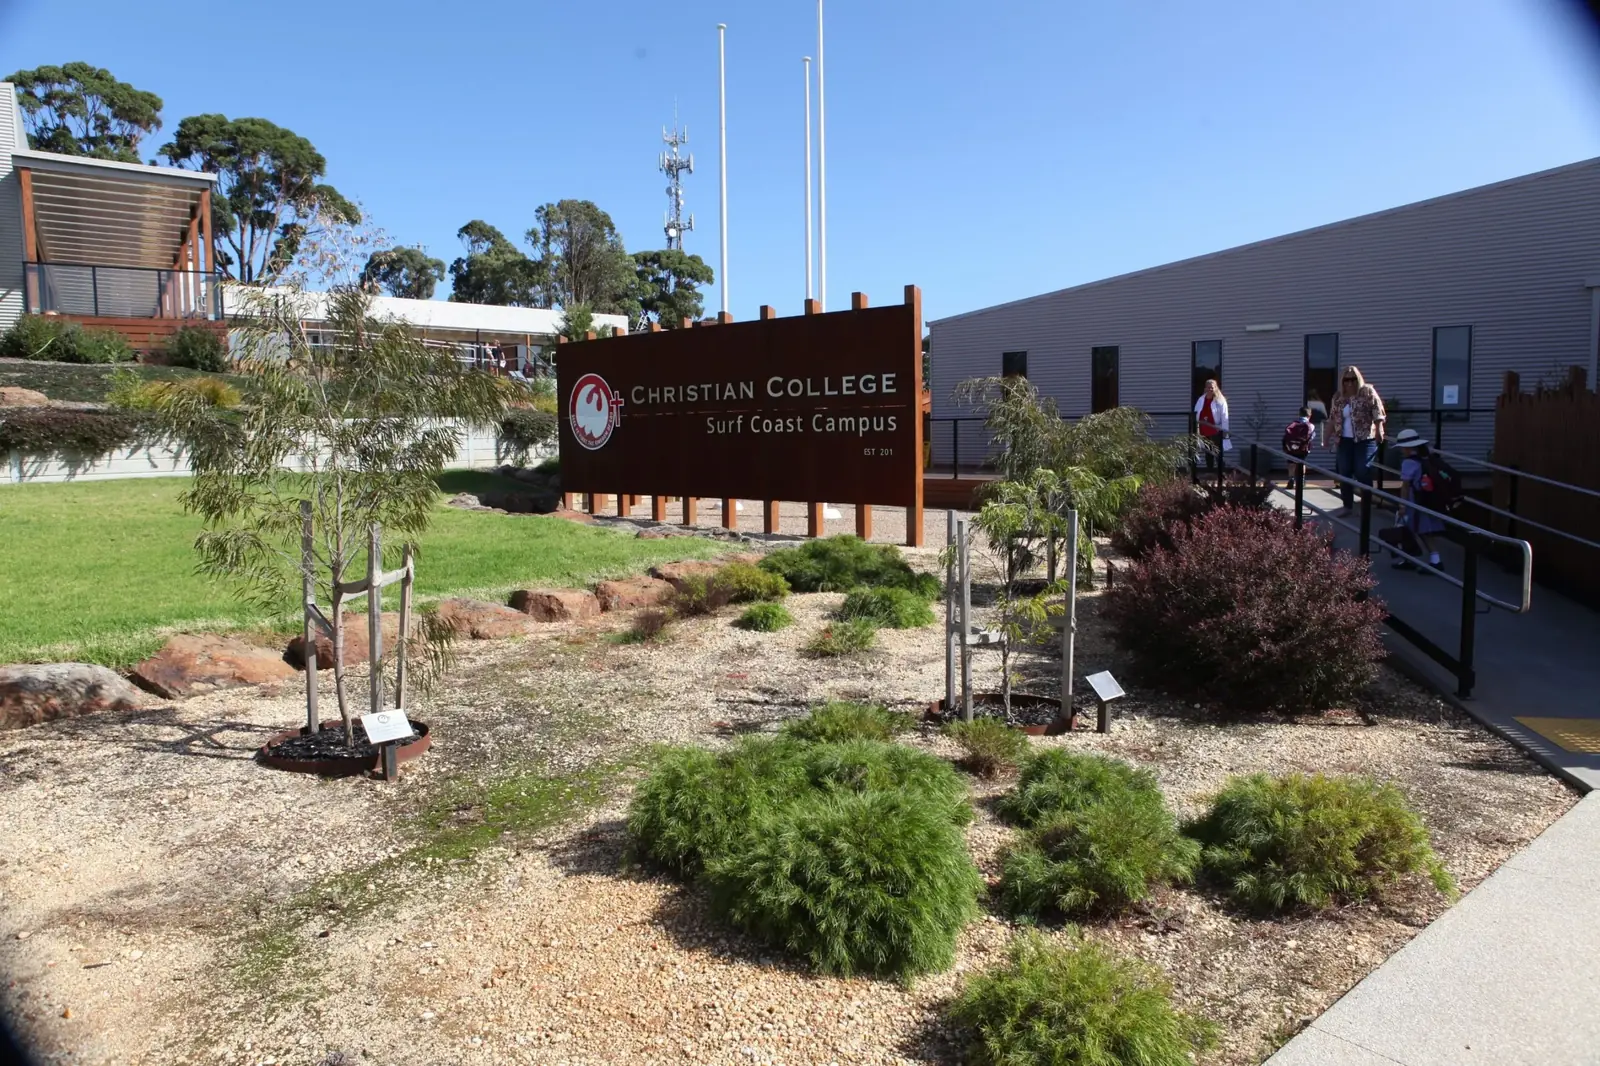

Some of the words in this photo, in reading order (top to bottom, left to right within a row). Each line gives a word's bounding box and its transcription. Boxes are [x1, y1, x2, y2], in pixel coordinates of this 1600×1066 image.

[632, 382, 754, 404] CHRISTIAN
[766, 373, 897, 398] COLLEGE
[707, 415, 743, 434] Surf
[750, 415, 804, 433] Coast
[812, 413, 897, 437] Campus
[863, 448, 876, 456] EST
[880, 448, 893, 456] 201
